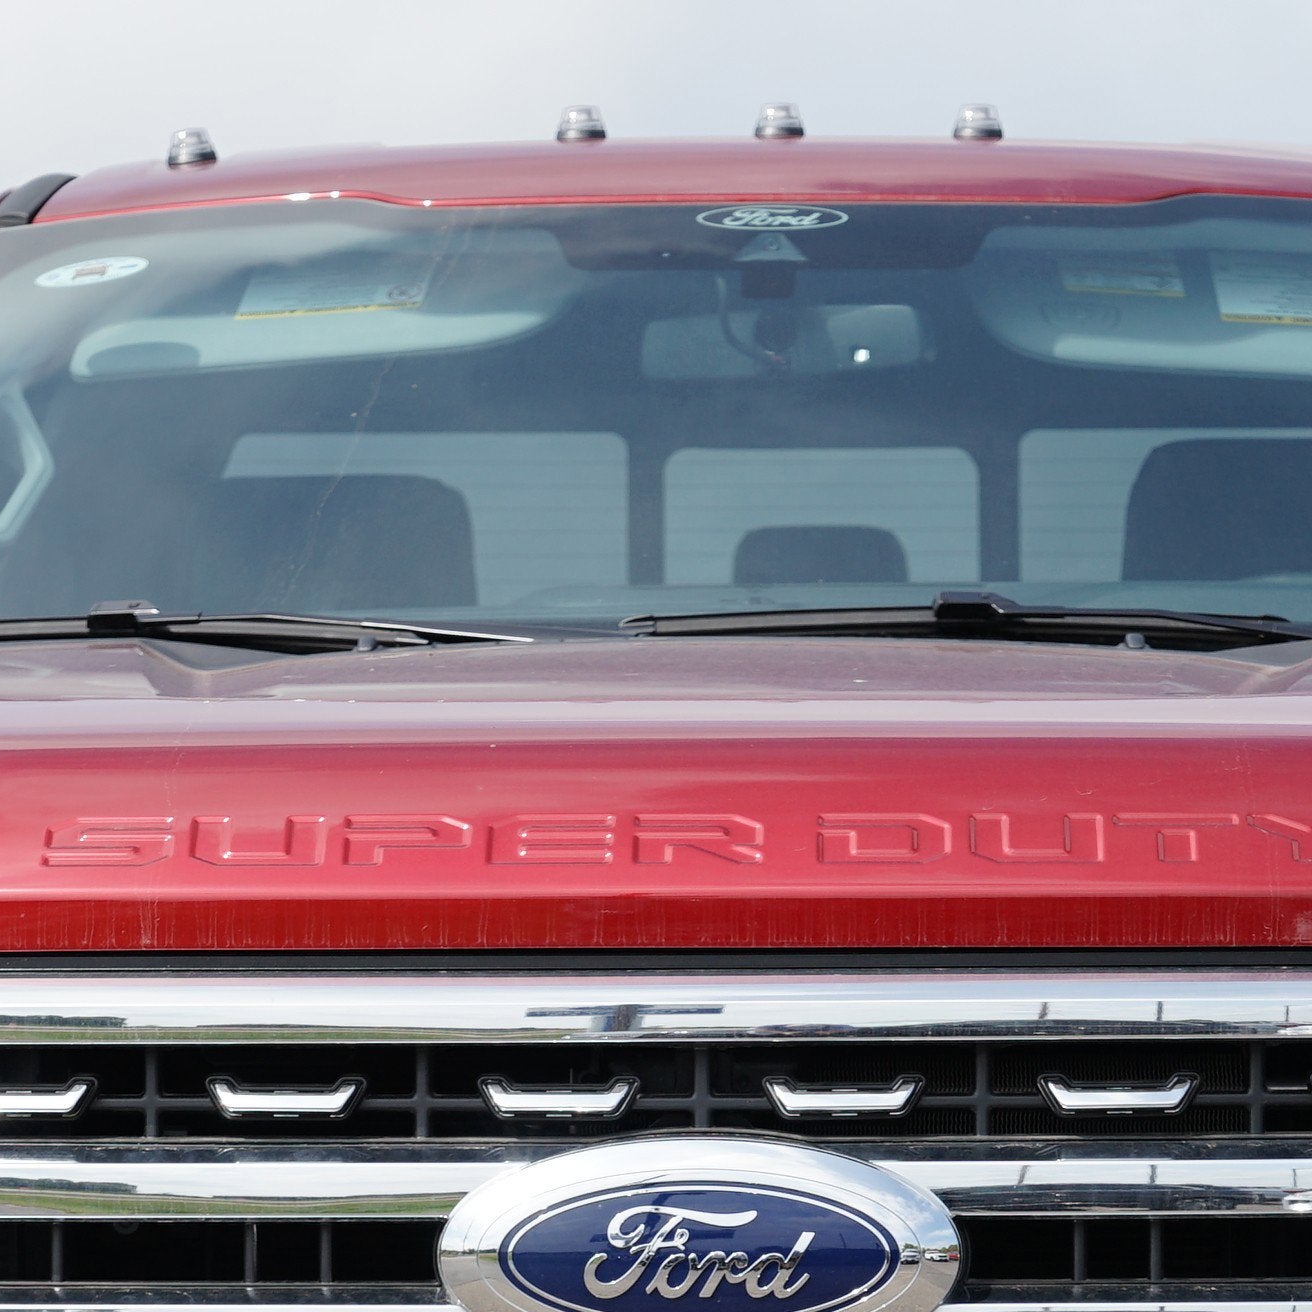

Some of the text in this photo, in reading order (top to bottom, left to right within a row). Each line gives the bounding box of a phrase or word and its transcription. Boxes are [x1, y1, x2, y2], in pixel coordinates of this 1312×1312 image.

[722, 207, 824, 226] Ford
[41, 814, 765, 868] SUPER
[583, 1205, 816, 1300] Ford
